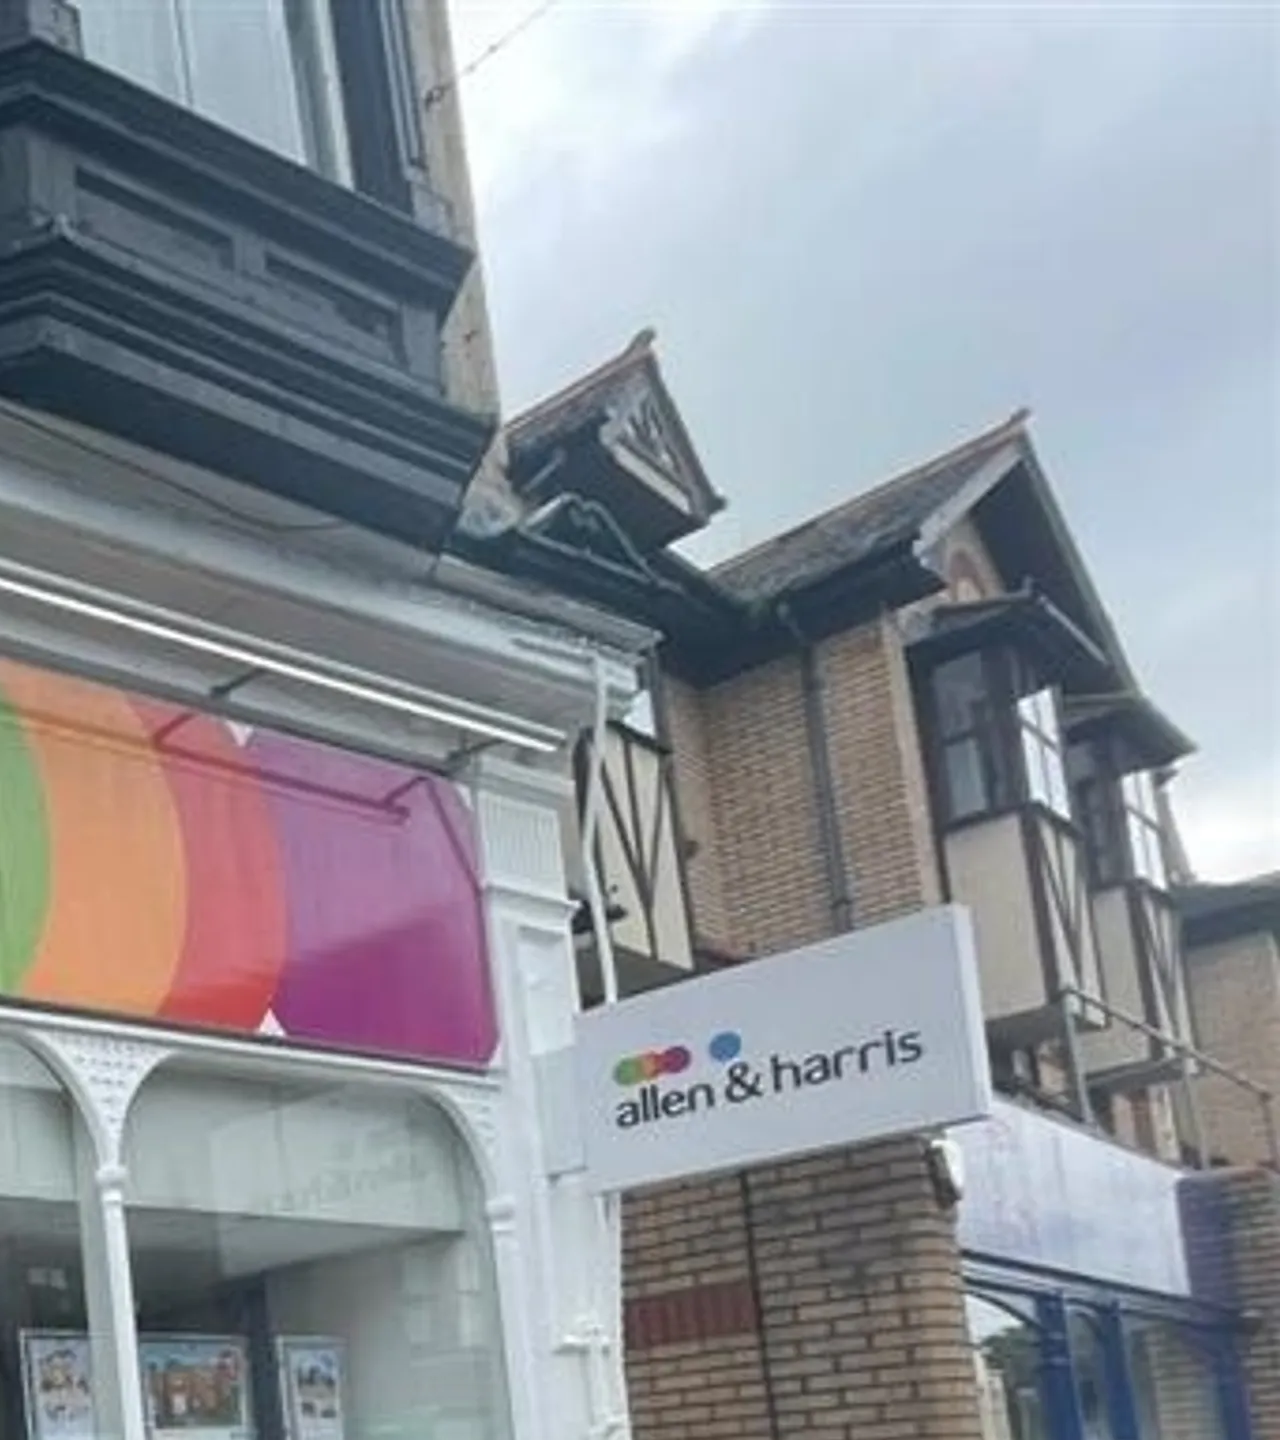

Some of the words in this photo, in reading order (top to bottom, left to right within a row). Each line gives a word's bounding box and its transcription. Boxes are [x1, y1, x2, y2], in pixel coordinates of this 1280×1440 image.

[616, 1083, 715, 1128] allen
[725, 1062, 763, 1103] &
[770, 1029, 923, 1092] harris
